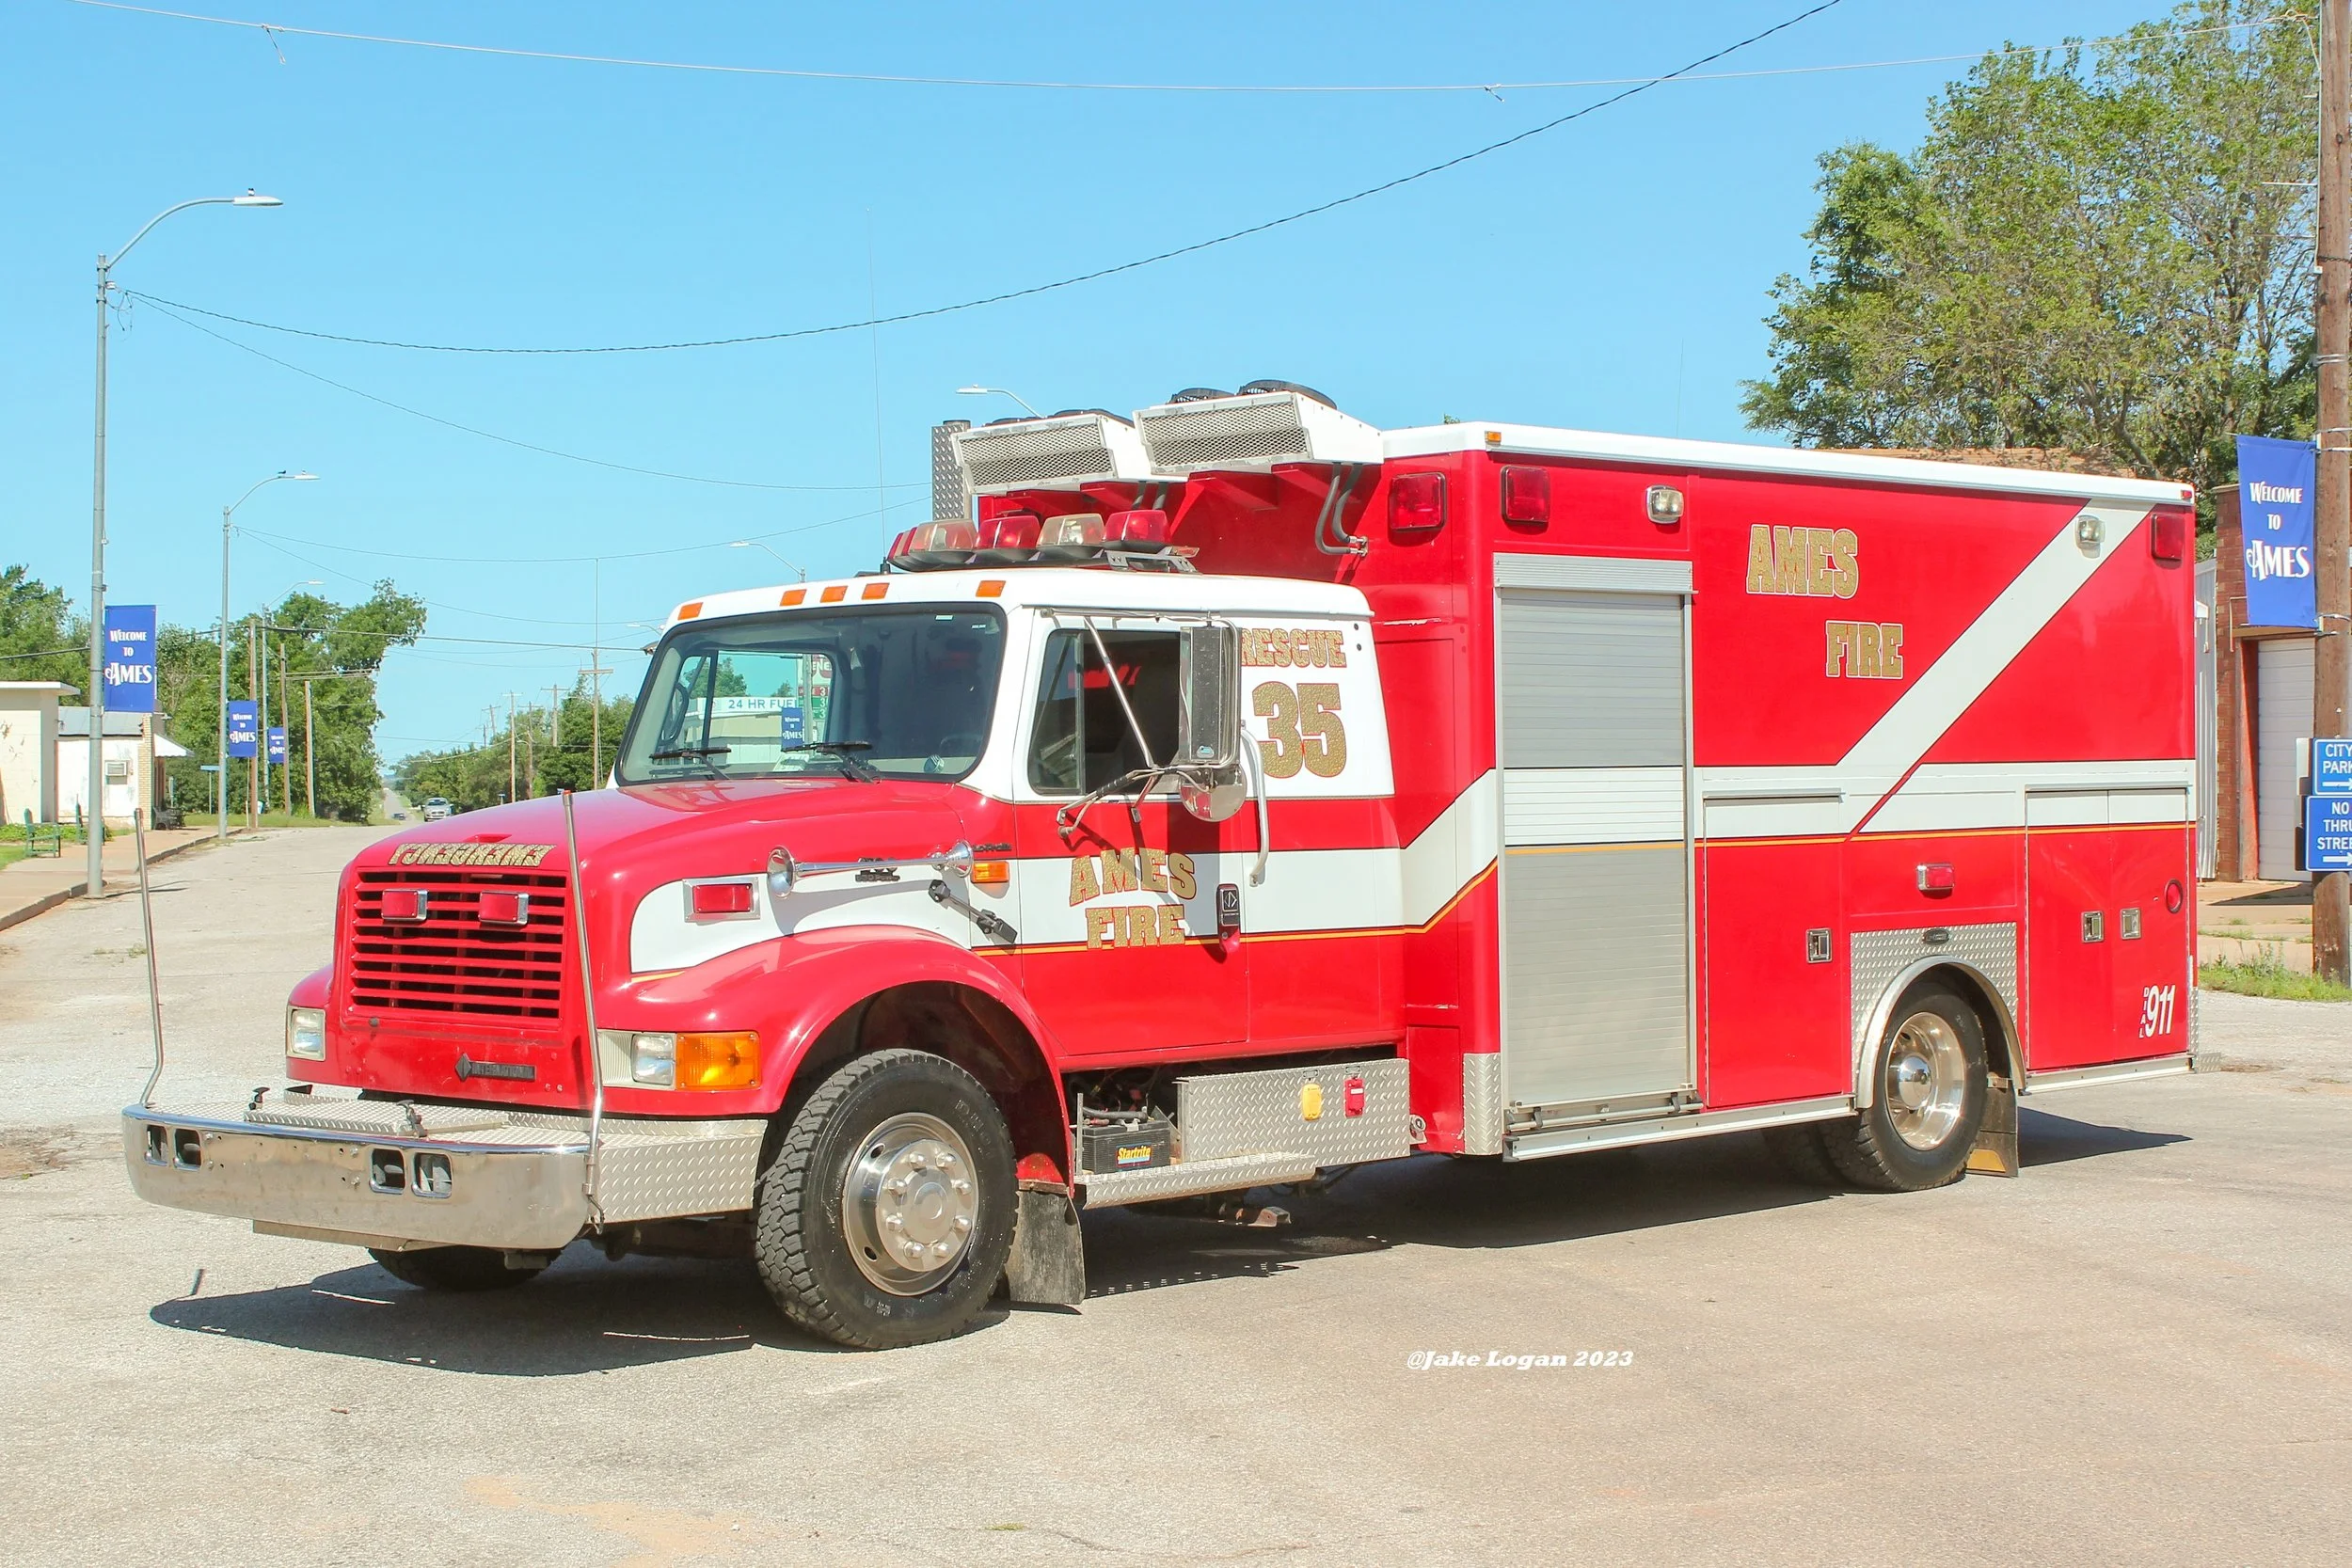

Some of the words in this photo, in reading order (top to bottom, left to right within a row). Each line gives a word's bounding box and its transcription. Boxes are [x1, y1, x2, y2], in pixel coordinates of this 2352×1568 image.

[2249, 482, 2303, 504] WELCOME
[2267, 514, 2281, 531] TO
[1746, 524, 1859, 599] AMES
[2246, 540, 2311, 581] AMES
[109, 629, 148, 642] WELCOME
[122, 646, 134, 657] TO
[1241, 628, 1347, 668] RESCUE
[1825, 620, 1903, 679] FIRE
[104, 662, 152, 686] AMES
[728, 699, 742, 708] 24
[748, 699, 766, 708] HR
[230, 730, 256, 743] AMES
[1252, 681, 1347, 779] 35
[2325, 743, 2352, 757] CITY
[2331, 801, 2350, 815] NO
[1069, 847, 1197, 907] AMES
[1085, 904, 1185, 949] FIRE
[2138, 987, 2150, 1038] DIAL
[2144, 984, 2176, 1037] 911
[471, 1063, 534, 1080] INTERNATIONAL
[1118, 1145, 1152, 1161] Startrite
